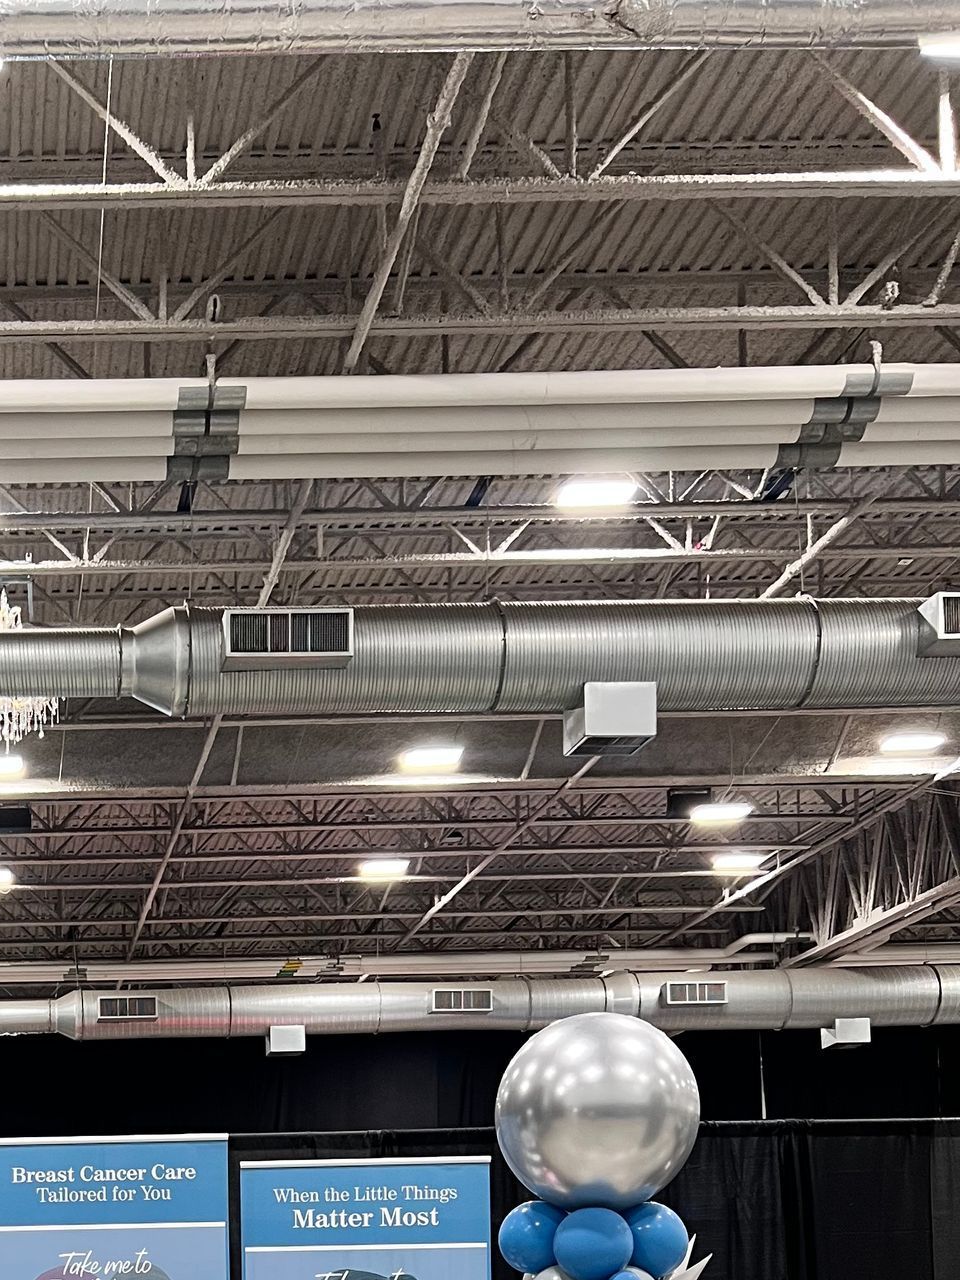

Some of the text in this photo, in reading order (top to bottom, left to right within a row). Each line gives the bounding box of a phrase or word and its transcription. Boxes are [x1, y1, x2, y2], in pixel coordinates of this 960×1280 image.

[12, 1164, 197, 1183] Breast Cancer Care
[36, 1186, 171, 1203] Tailored for You
[273, 1186, 458, 1203] When the Little Things
[292, 1206, 439, 1229] Matter Most
[59, 1248, 152, 1278] Take me to
